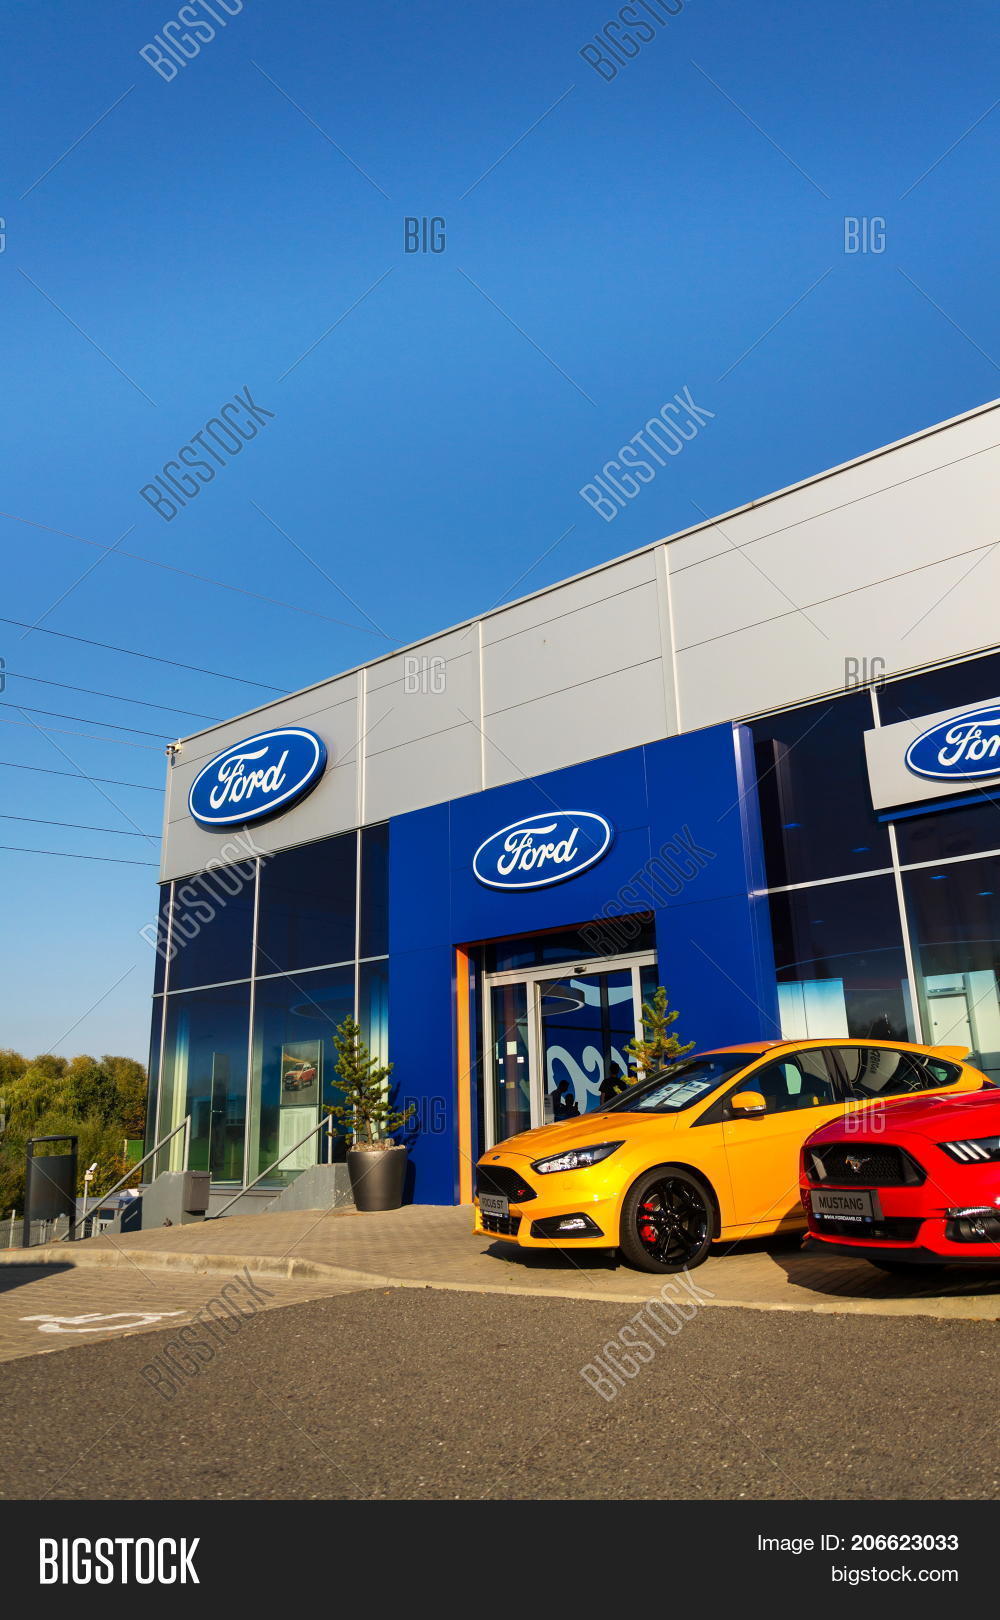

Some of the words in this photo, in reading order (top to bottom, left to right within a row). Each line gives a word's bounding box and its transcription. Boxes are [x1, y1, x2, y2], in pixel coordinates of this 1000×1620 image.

[209, 745, 289, 810] Ford
[496, 822, 580, 876] Ford
[818, 1196, 864, 1211] MUSTANG
